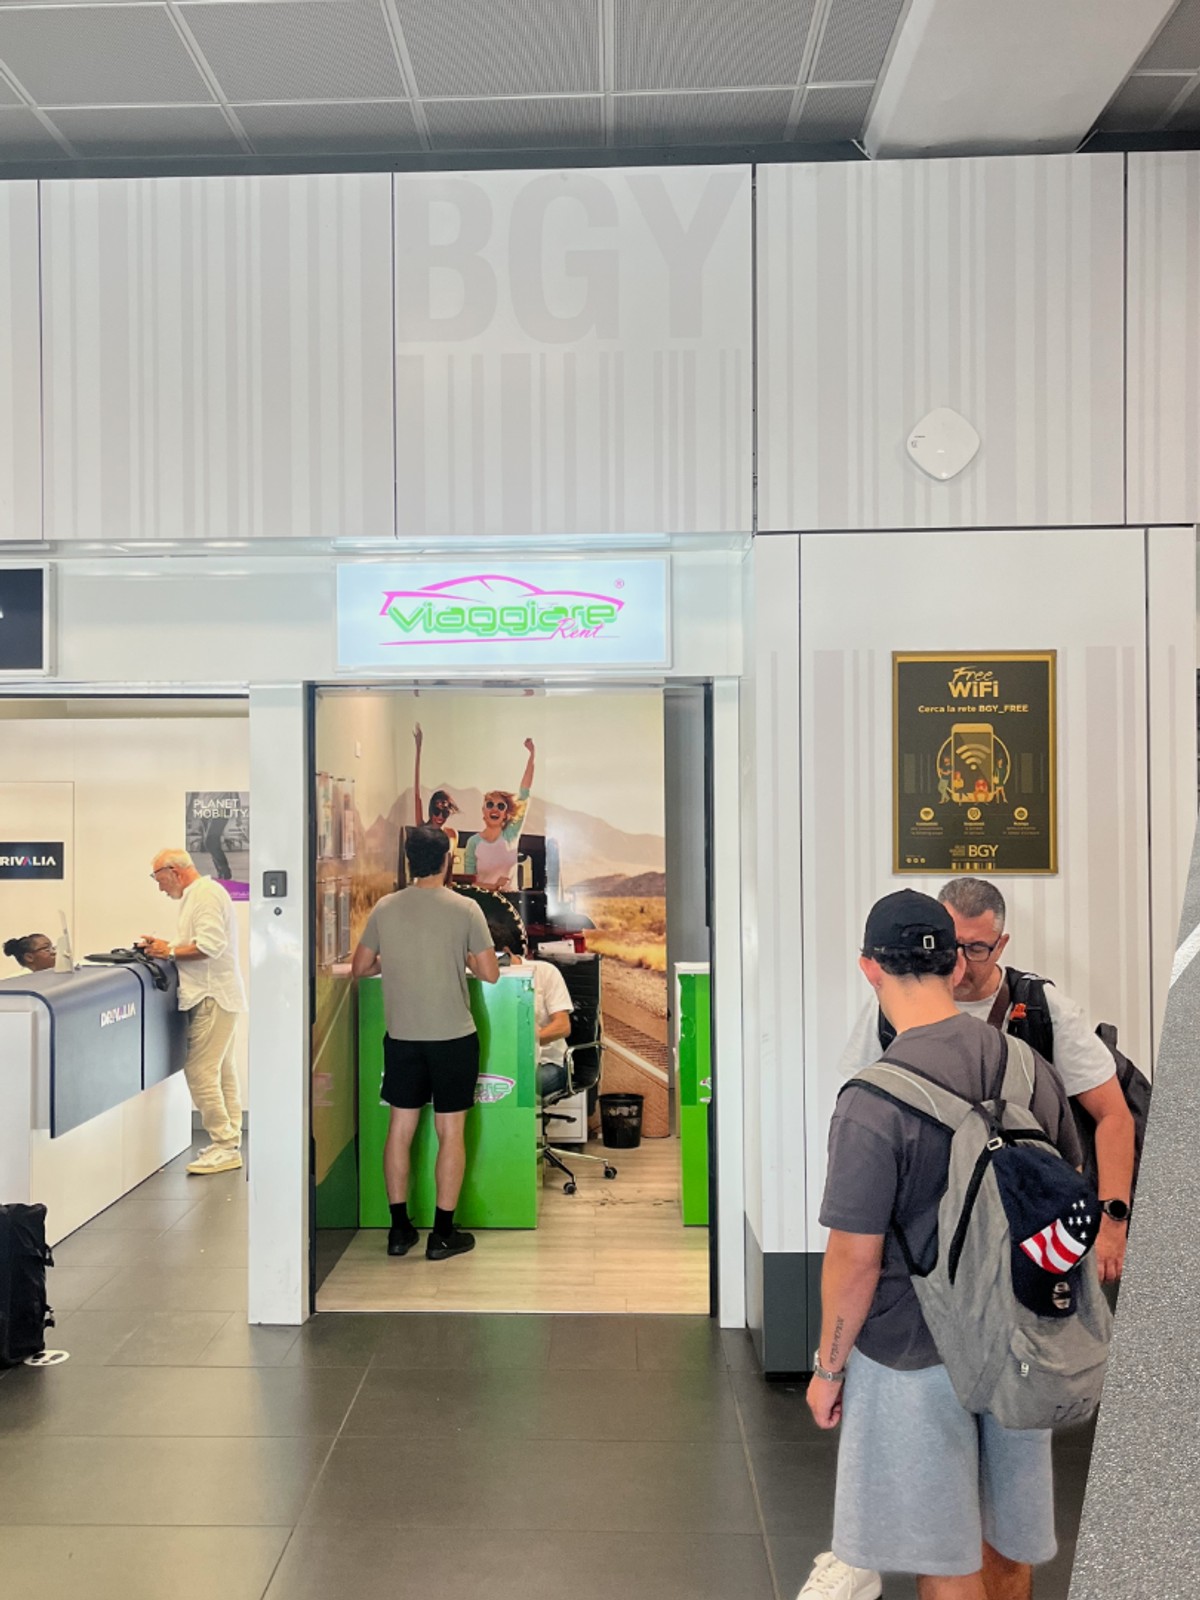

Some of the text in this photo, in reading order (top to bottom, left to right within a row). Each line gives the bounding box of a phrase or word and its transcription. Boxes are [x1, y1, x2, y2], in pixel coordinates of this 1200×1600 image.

[396, 171, 746, 344] BGY
[552, 617, 605, 639] Rent
[953, 666, 994, 684] Free
[948, 680, 999, 698] WiFi
[918, 704, 945, 713] Cerca
[946, 704, 956, 713] la
[957, 704, 977, 713] rete
[193, 799, 239, 809] PLANET
[968, 844, 999, 858] BGY
[0, 855, 57, 867] RIVALIA
